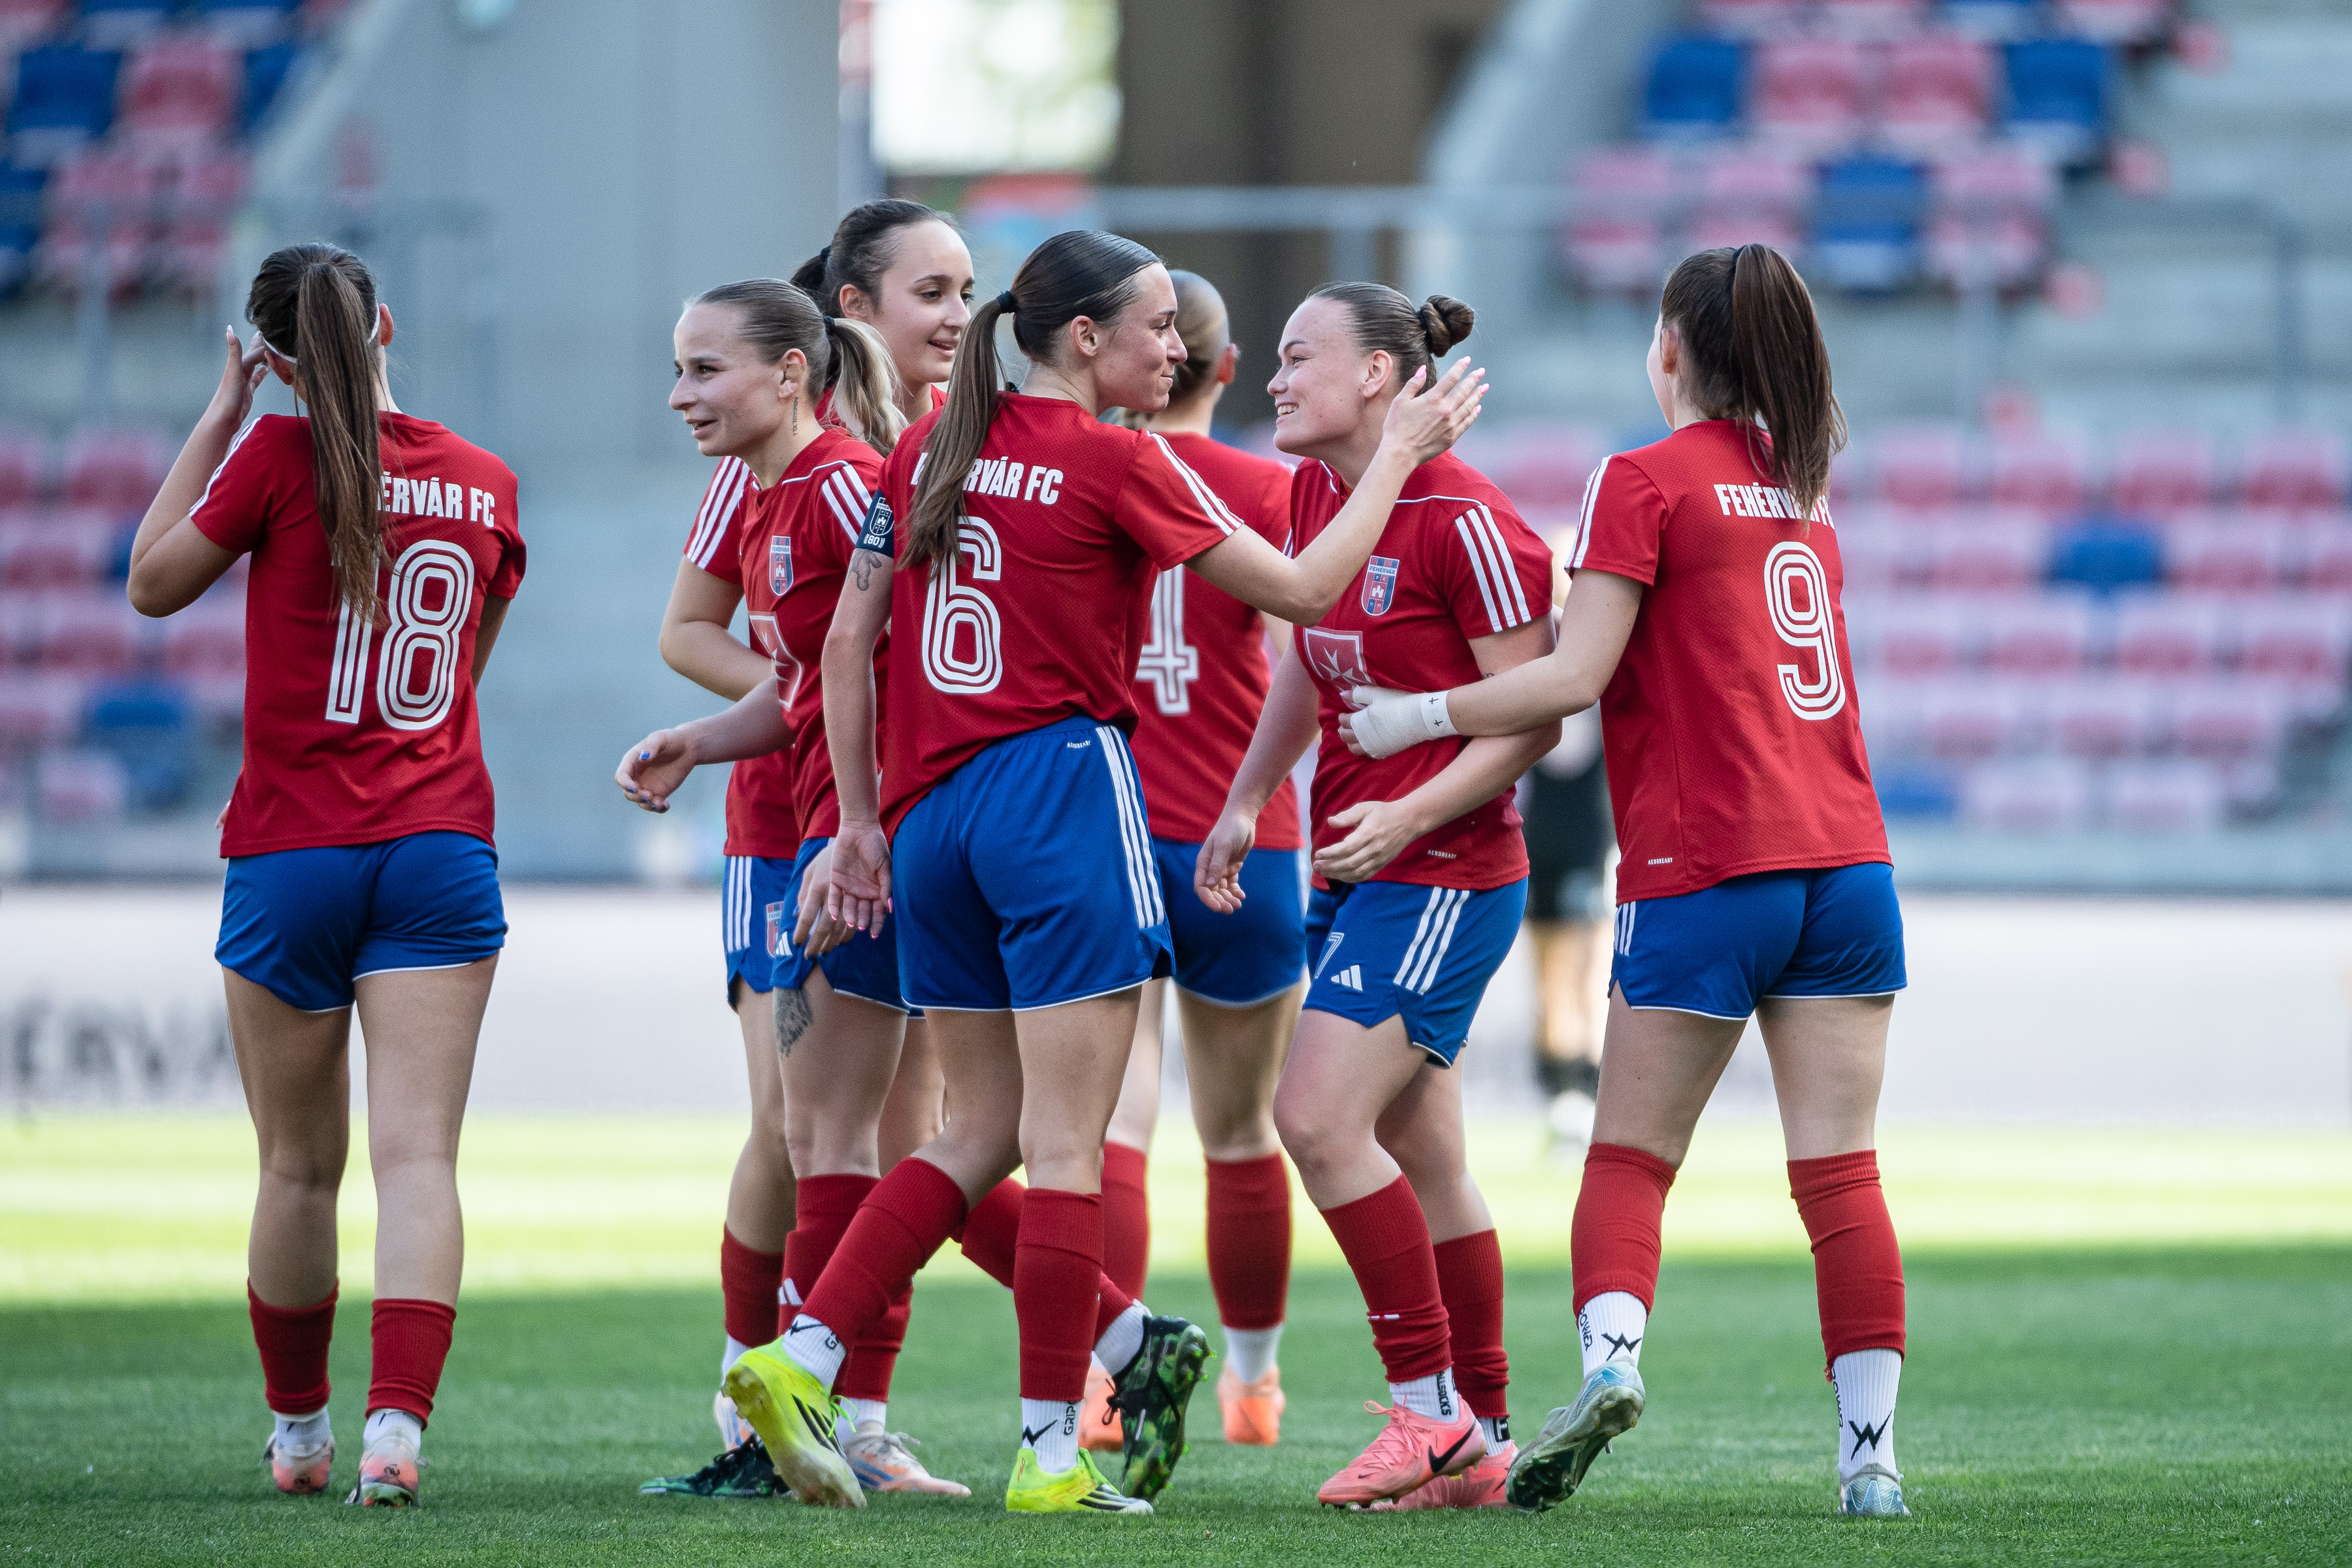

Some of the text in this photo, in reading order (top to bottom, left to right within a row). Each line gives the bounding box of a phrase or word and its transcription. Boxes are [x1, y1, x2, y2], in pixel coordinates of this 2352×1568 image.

[377, 471, 496, 528] ÉRVÁR FC
[910, 451, 1064, 505] RVÁR FC
[1713, 482, 1821, 523] FEHÉRV
[867, 535, 880, 546] 80
[1369, 566, 1396, 574] FEHÉRVÁR
[922, 516, 1003, 695] 6
[325, 540, 475, 731] 18
[1135, 563, 1200, 717] 4
[1763, 541, 1846, 721] 9
[1427, 849, 1457, 859] AEROREADY
[1315, 932, 1345, 979] 7
[1064, 1402, 1076, 1435] GRIP
